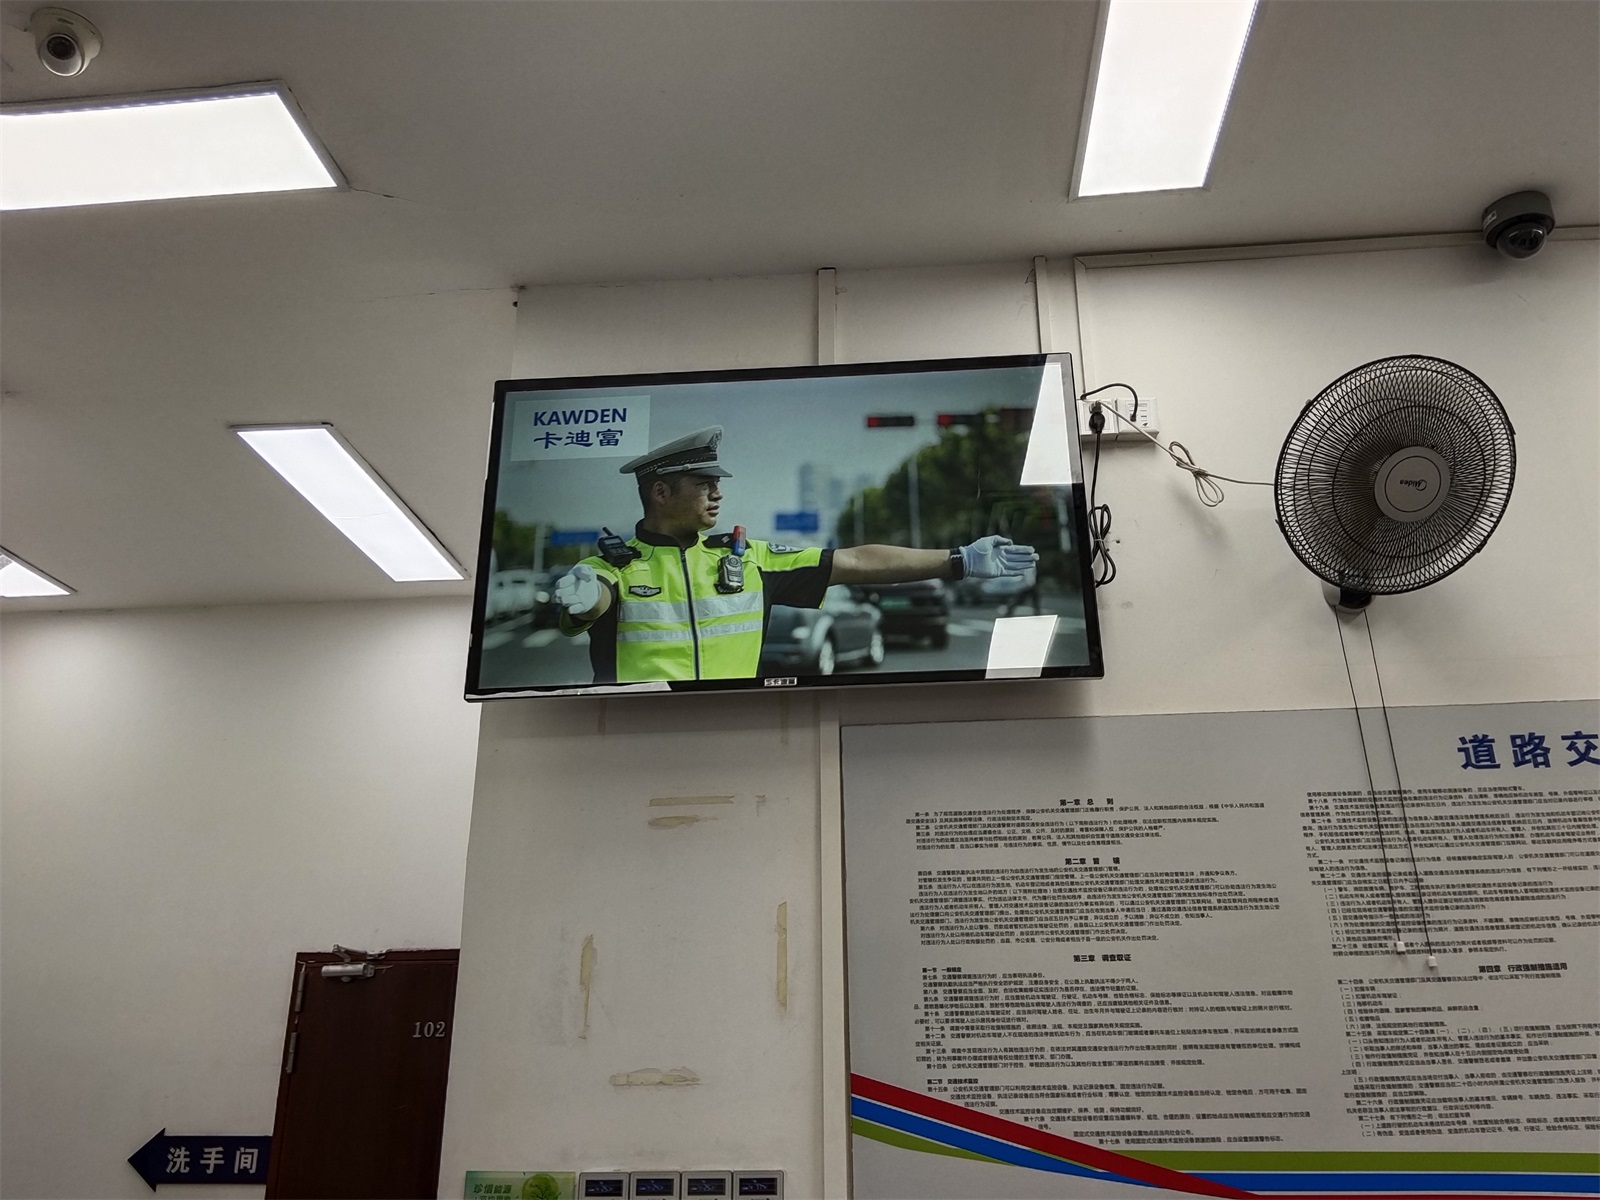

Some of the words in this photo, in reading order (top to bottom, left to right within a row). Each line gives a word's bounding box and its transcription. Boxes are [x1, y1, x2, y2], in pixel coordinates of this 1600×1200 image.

[533, 408, 627, 426] KAWDEN
[534, 428, 624, 450] 卡迪富
[1457, 730, 1600, 770] 道路交
[412, 1021, 446, 1038] 102
[166, 1146, 259, 1174] 洗手间
[473, 1184, 512, 1194] 珍惜能源
